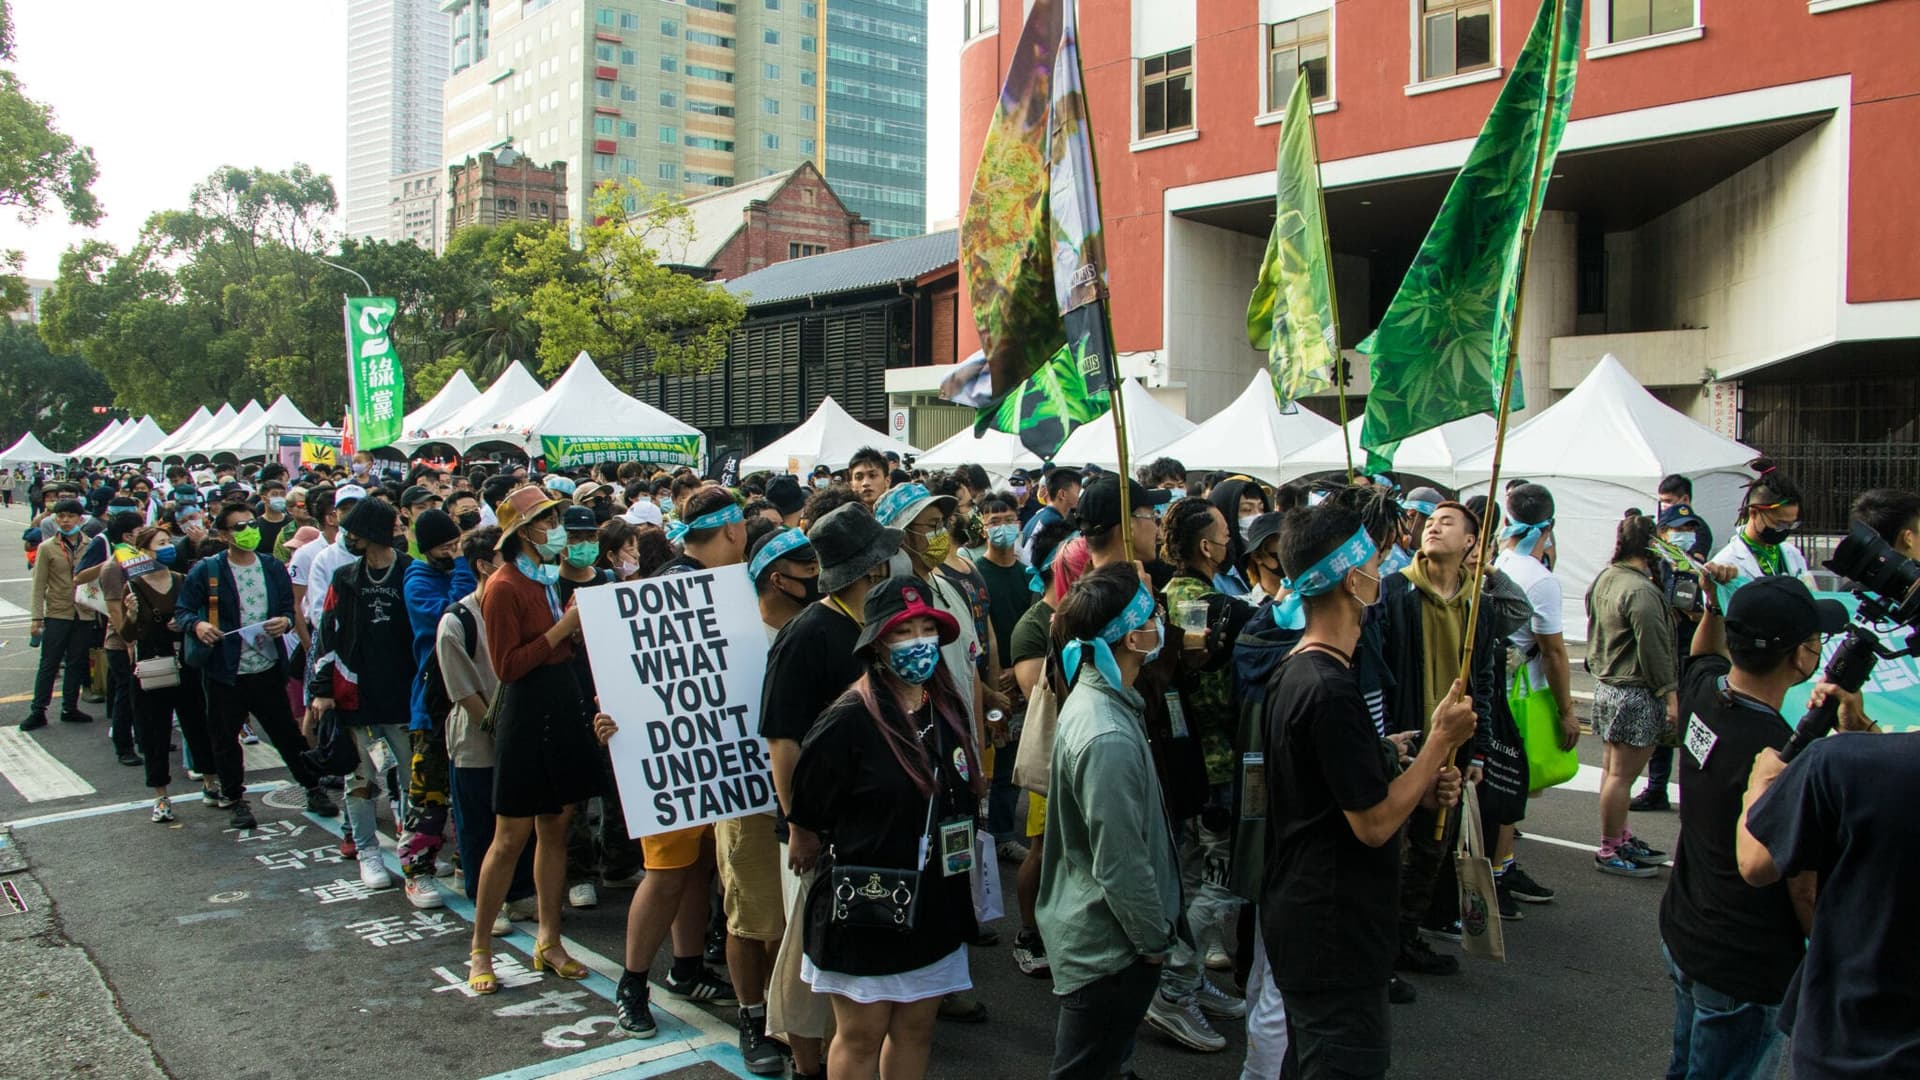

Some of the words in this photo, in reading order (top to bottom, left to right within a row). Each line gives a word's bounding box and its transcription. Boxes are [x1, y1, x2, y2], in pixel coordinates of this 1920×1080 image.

[369, 356, 395, 422] 綠黨
[615, 574, 715, 619] DON'T
[630, 608, 721, 650] HATE
[631, 639, 728, 684] WHAT
[652, 674, 727, 716] YOU
[646, 704, 749, 754] DON'T
[641, 738, 771, 791] UNDER-
